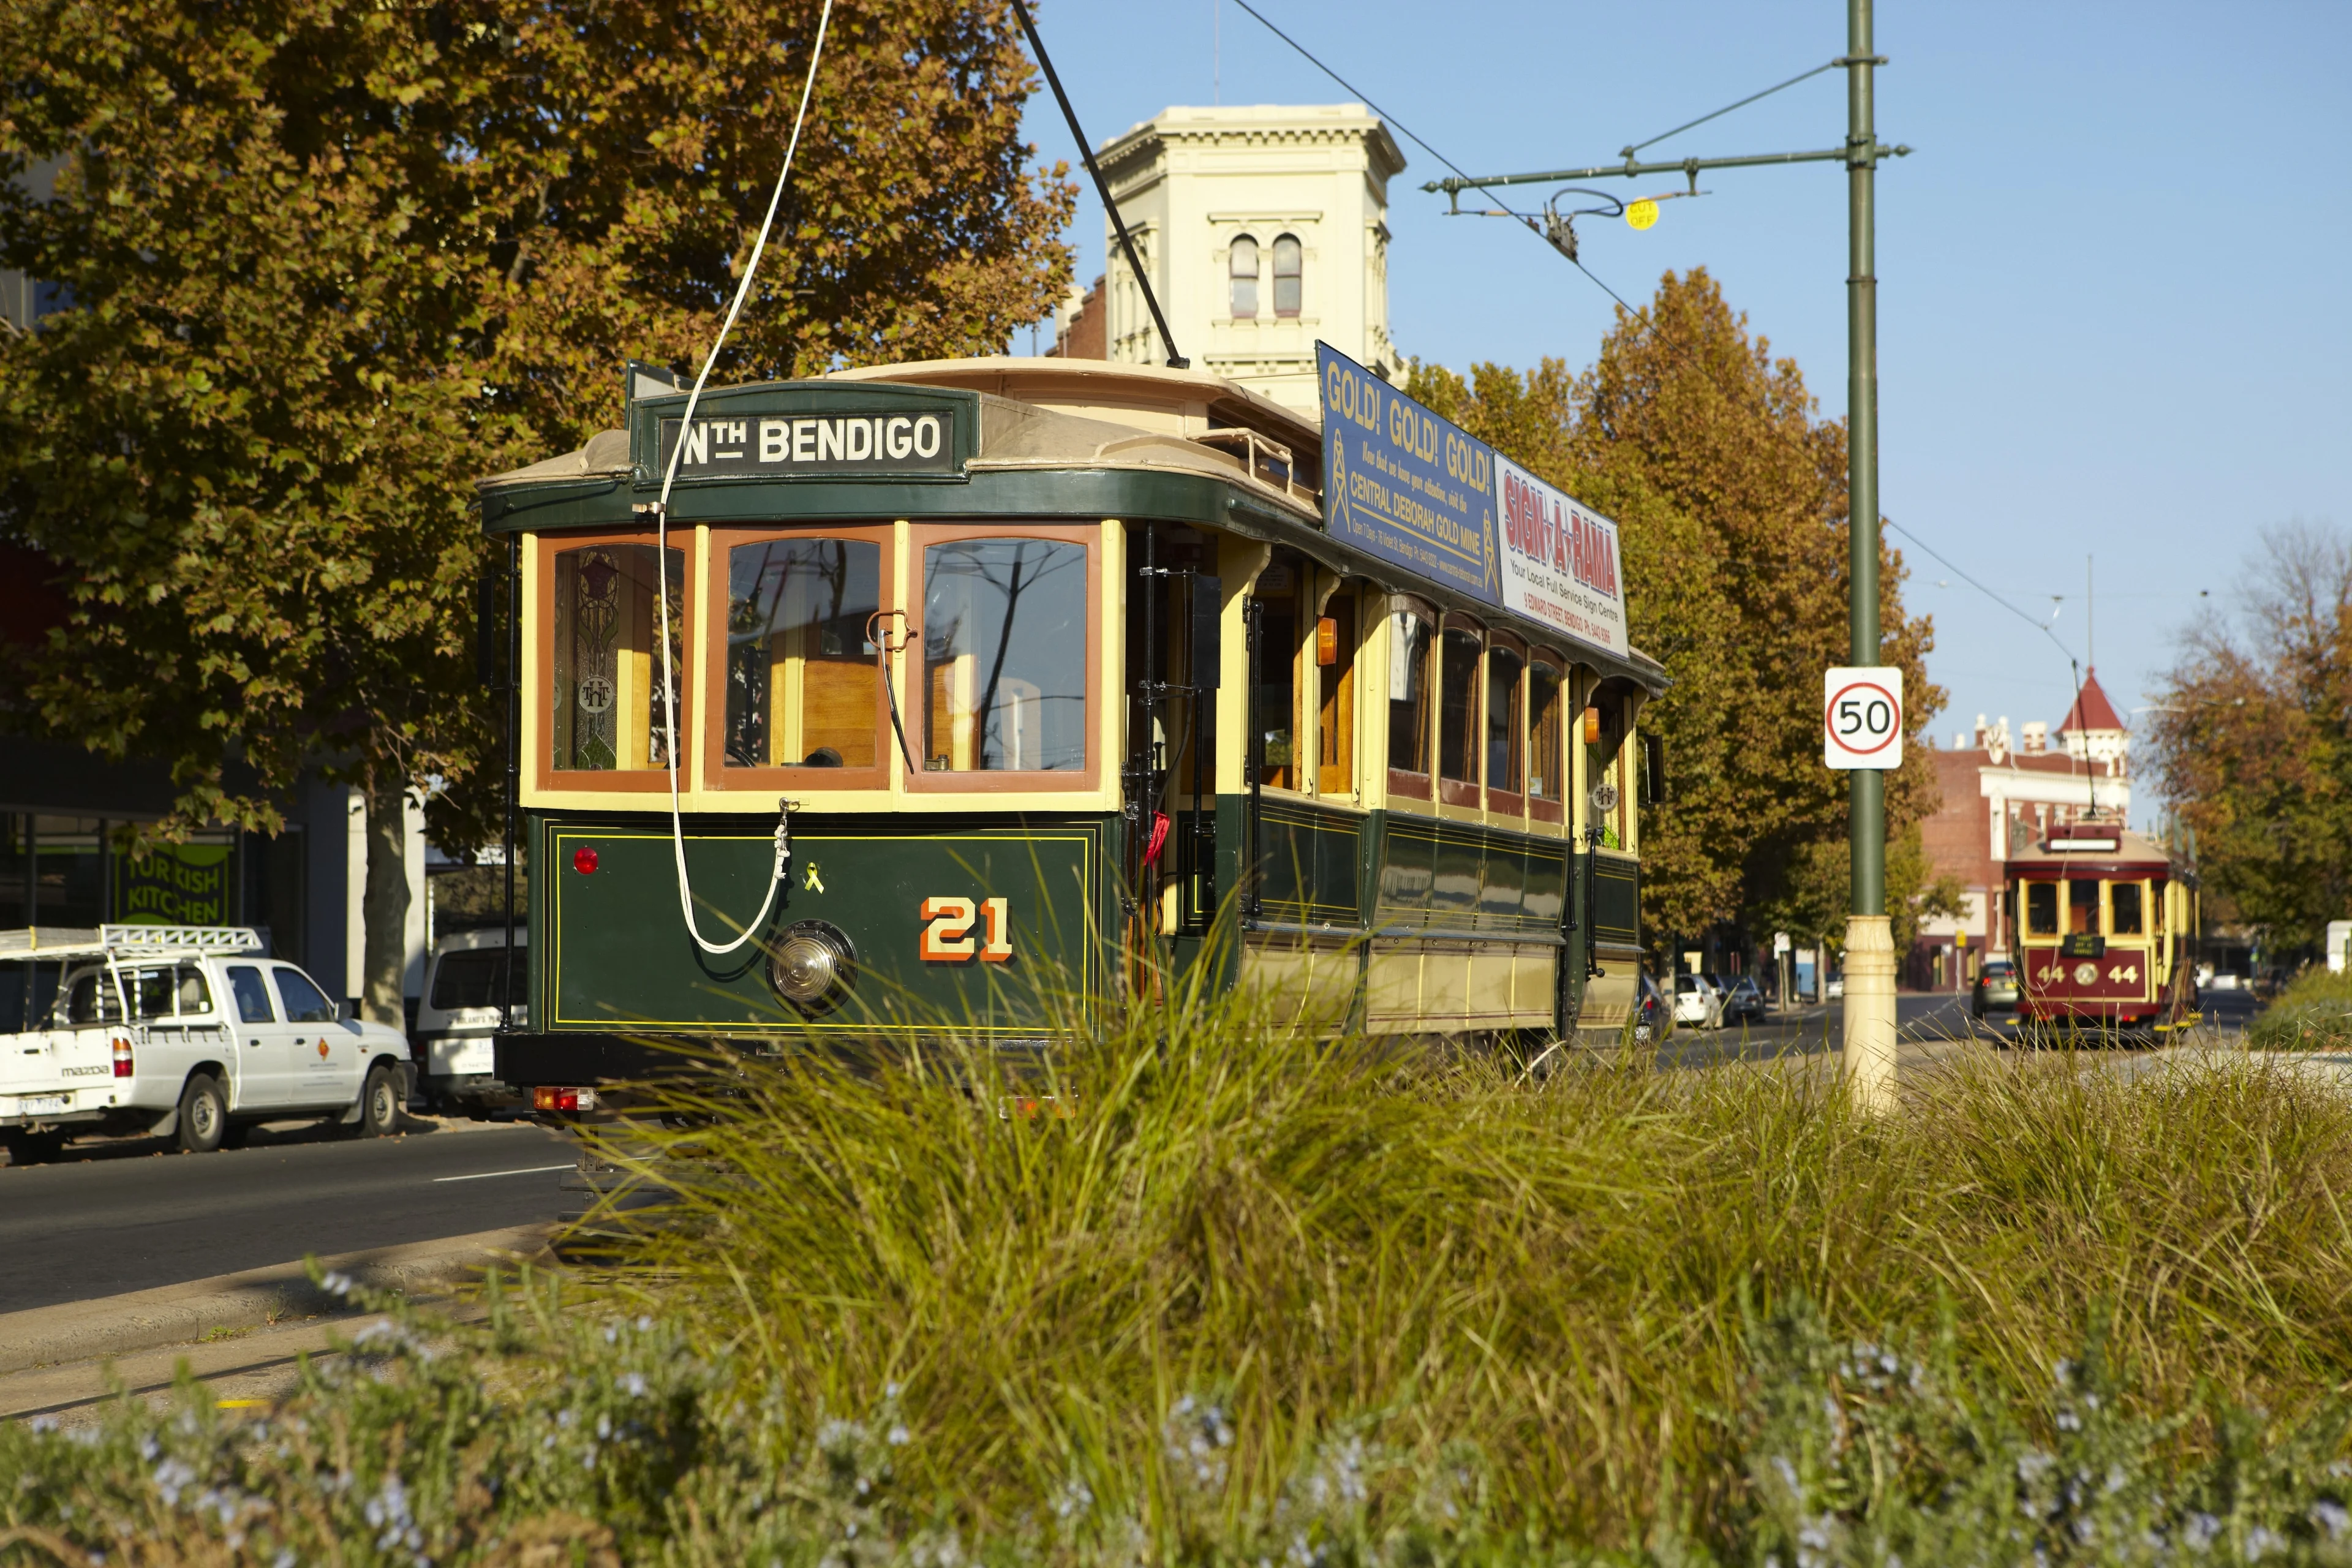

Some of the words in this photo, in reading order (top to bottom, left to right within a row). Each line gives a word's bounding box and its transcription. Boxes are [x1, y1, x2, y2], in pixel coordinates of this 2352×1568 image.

[1630, 203, 1654, 214] CUT
[1630, 215, 1654, 227] OFF
[759, 416, 940, 462] BENDIGO
[1327, 361, 1380, 435] GOLD!
[1389, 399, 1438, 467] GOLD!
[1446, 432, 1490, 497] GOLD!
[1362, 440, 1374, 466] Now
[1376, 450, 1387, 473] that
[1389, 461, 1396, 477] we
[1398, 460, 1410, 484] have
[1411, 474, 1423, 492] your
[1425, 478, 1447, 507] attention,
[1449, 489, 1458, 510] visit
[1351, 471, 1391, 514] CENTRAL
[1393, 492, 1434, 534] DEBORAH
[1436, 514, 1458, 545] GOLD
[1460, 526, 1480, 556] MINE
[1352, 518, 1363, 537] Open
[1366, 524, 1375, 543] Days
[1382, 532, 1393, 549] Violet
[1399, 539, 1413, 560] Bendigo
[1510, 559, 1525, 579] Your
[1527, 567, 1545, 587] Local
[1547, 576, 1558, 595] Full
[1559, 584, 1582, 606] Service
[1583, 595, 1597, 614] Sign
[1598, 602, 1618, 622] Centre
[1524, 592, 1528, 608] 9
[1528, 593, 1547, 616] EDWARD
[1564, 609, 1583, 633] BENDIGO
[1591, 623, 1600, 640] 5443
[1840, 700, 1890, 734] 50
[126, 855, 219, 894] TURKISH
[127, 885, 219, 924] KITCHEN
[920, 897, 1014, 963] 21
[2037, 965, 2066, 983] 44
[2108, 965, 2138, 984] 44
[61, 1065, 109, 1077] mazda
